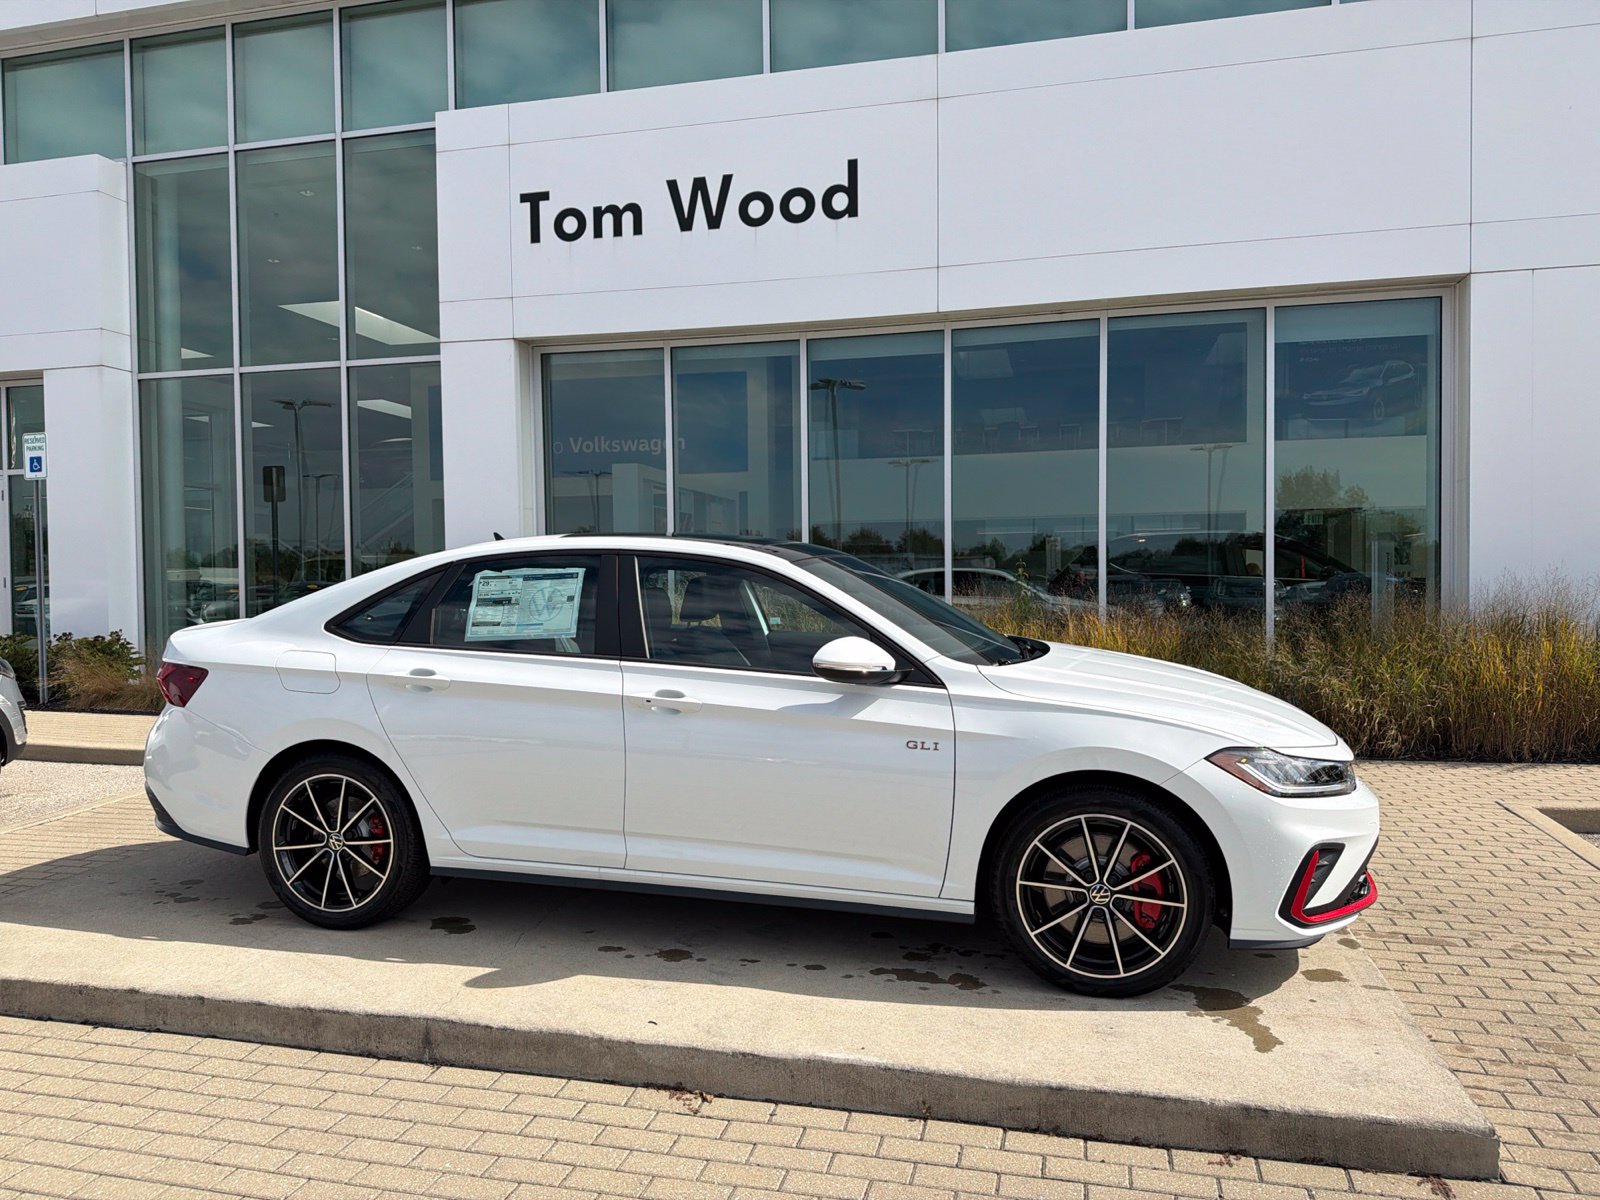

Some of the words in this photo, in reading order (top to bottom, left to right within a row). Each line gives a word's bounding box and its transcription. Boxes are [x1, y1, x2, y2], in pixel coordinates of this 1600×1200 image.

[519, 190, 643, 244] Tom
[666, 158, 859, 232] Wood
[569, 435, 686, 455] Volkswagn
[906, 740, 939, 751] GLI
